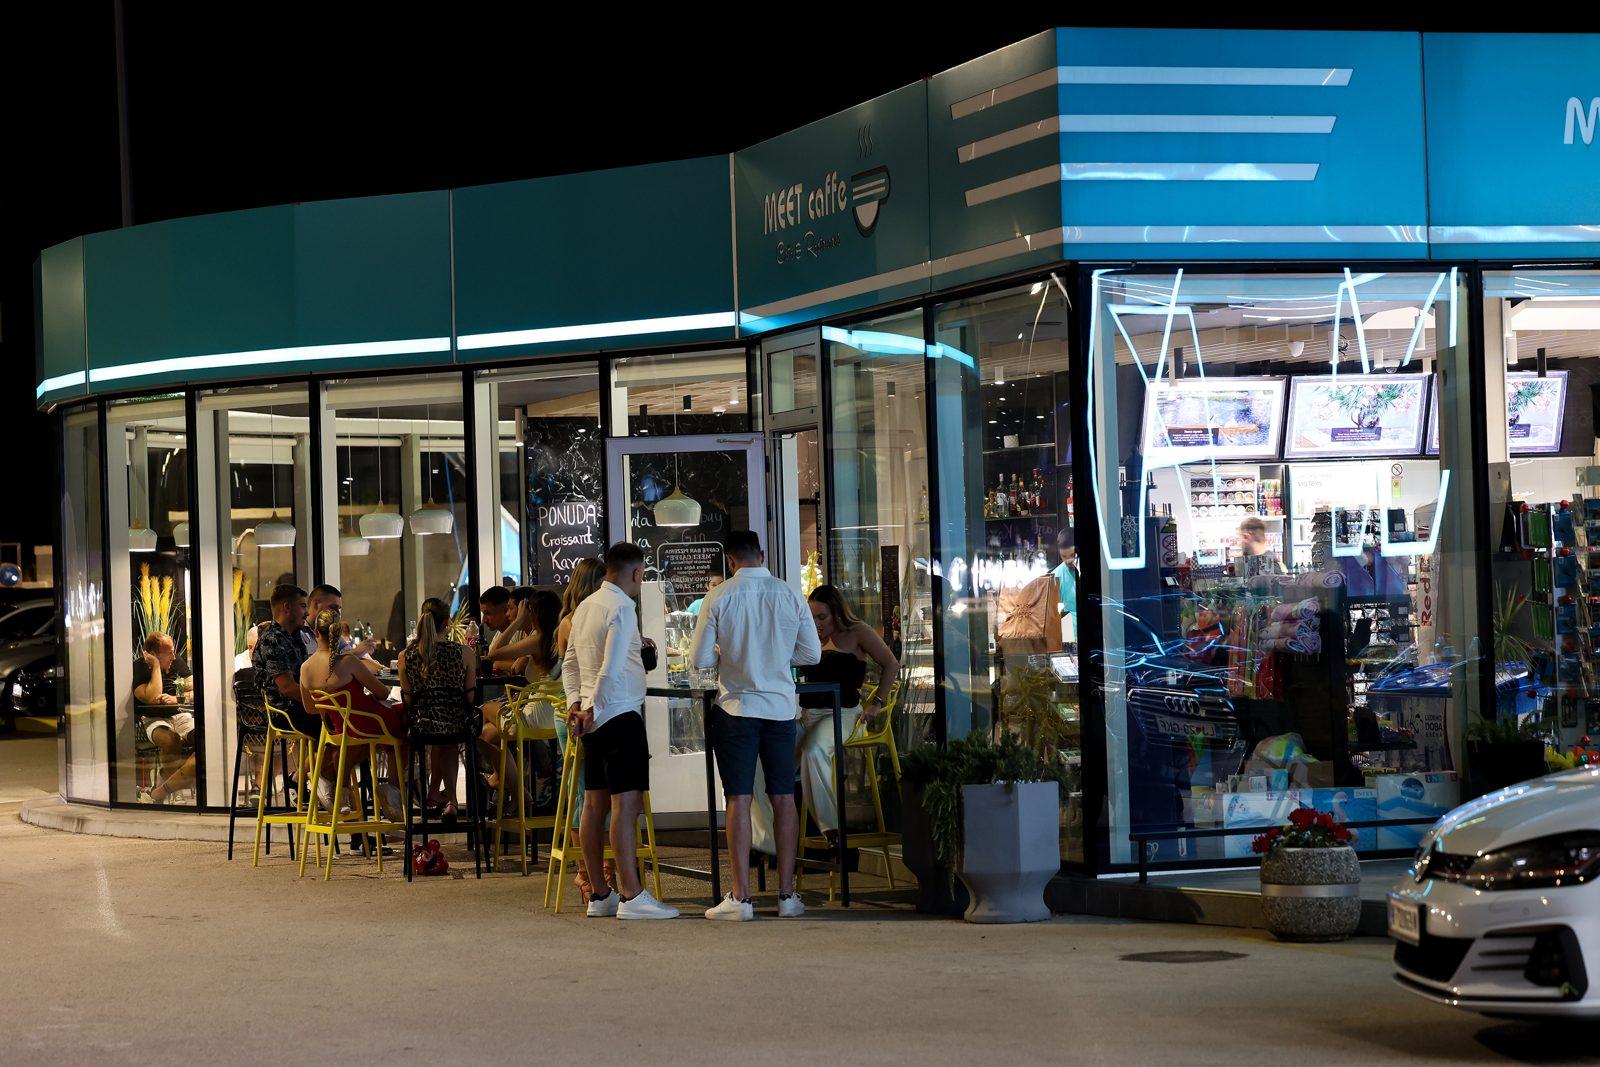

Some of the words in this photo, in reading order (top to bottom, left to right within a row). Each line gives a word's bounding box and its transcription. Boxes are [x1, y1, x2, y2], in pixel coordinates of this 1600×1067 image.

[764, 183, 803, 235] MEET
[808, 170, 847, 220] caffe
[537, 504, 596, 527] PONUDA
[541, 525, 595, 548] Croissant
[1419, 577, 1433, 627] Red
[1425, 722, 1443, 731] DOBA
